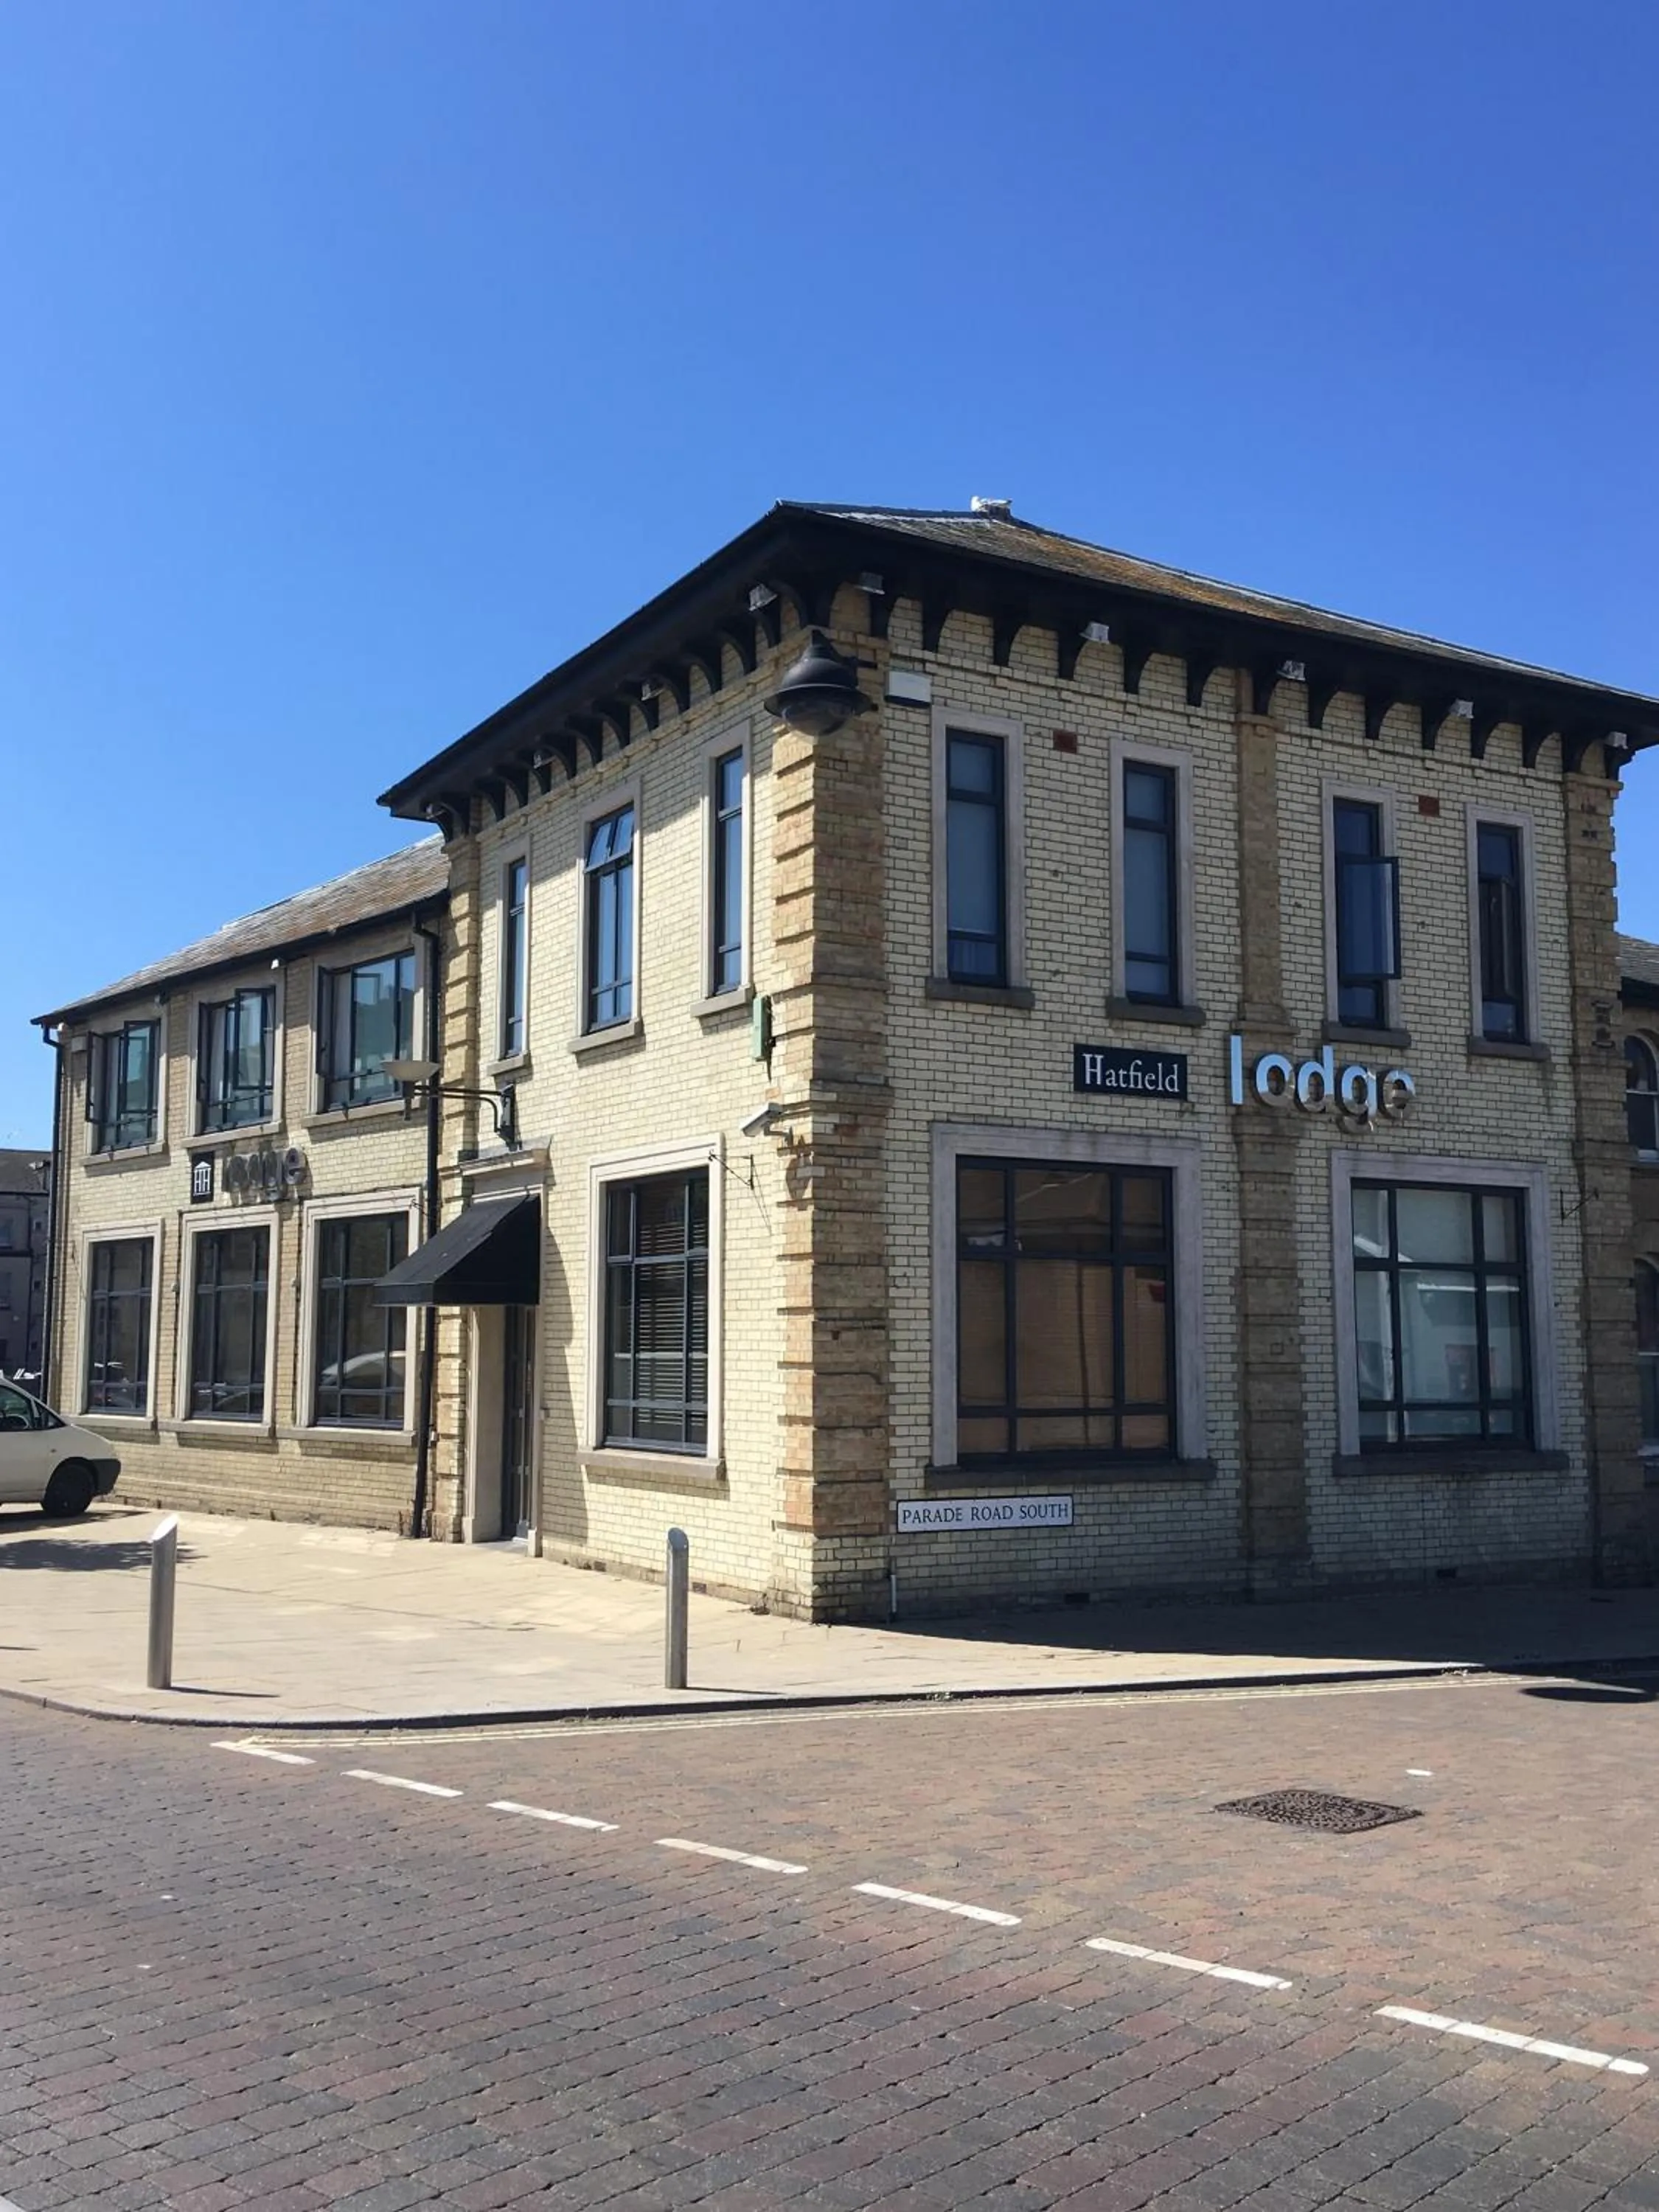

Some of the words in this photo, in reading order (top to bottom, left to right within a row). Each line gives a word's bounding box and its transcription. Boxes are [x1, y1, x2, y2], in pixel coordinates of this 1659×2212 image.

[1082, 1053, 1180, 1093] Hatfield
[1229, 1034, 1416, 1134] lodge
[902, 1508, 963, 1524] PARADE
[970, 1504, 1014, 1522] ROAD
[1020, 1503, 1068, 1520] SOUTH
